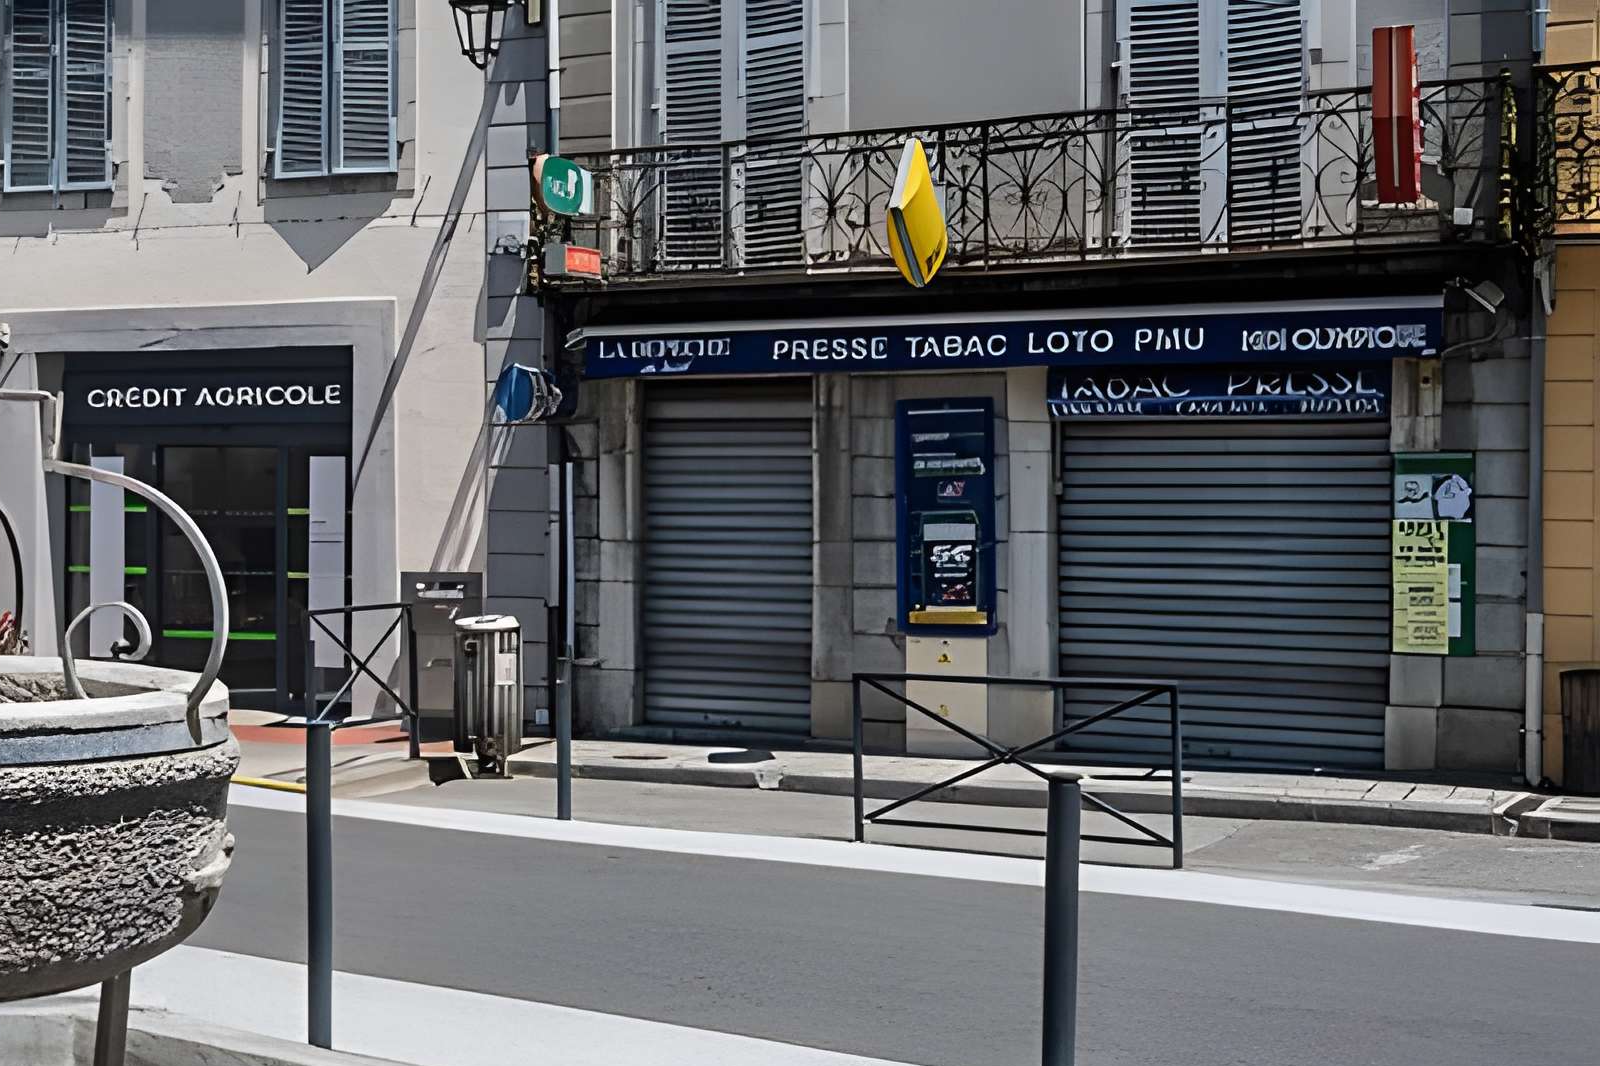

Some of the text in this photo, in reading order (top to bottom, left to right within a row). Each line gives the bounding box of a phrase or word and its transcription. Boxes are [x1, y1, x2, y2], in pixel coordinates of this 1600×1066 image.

[772, 327, 1204, 360] PRESSE TABAC LOTO PMU
[195, 384, 342, 406] AGRICOLE
